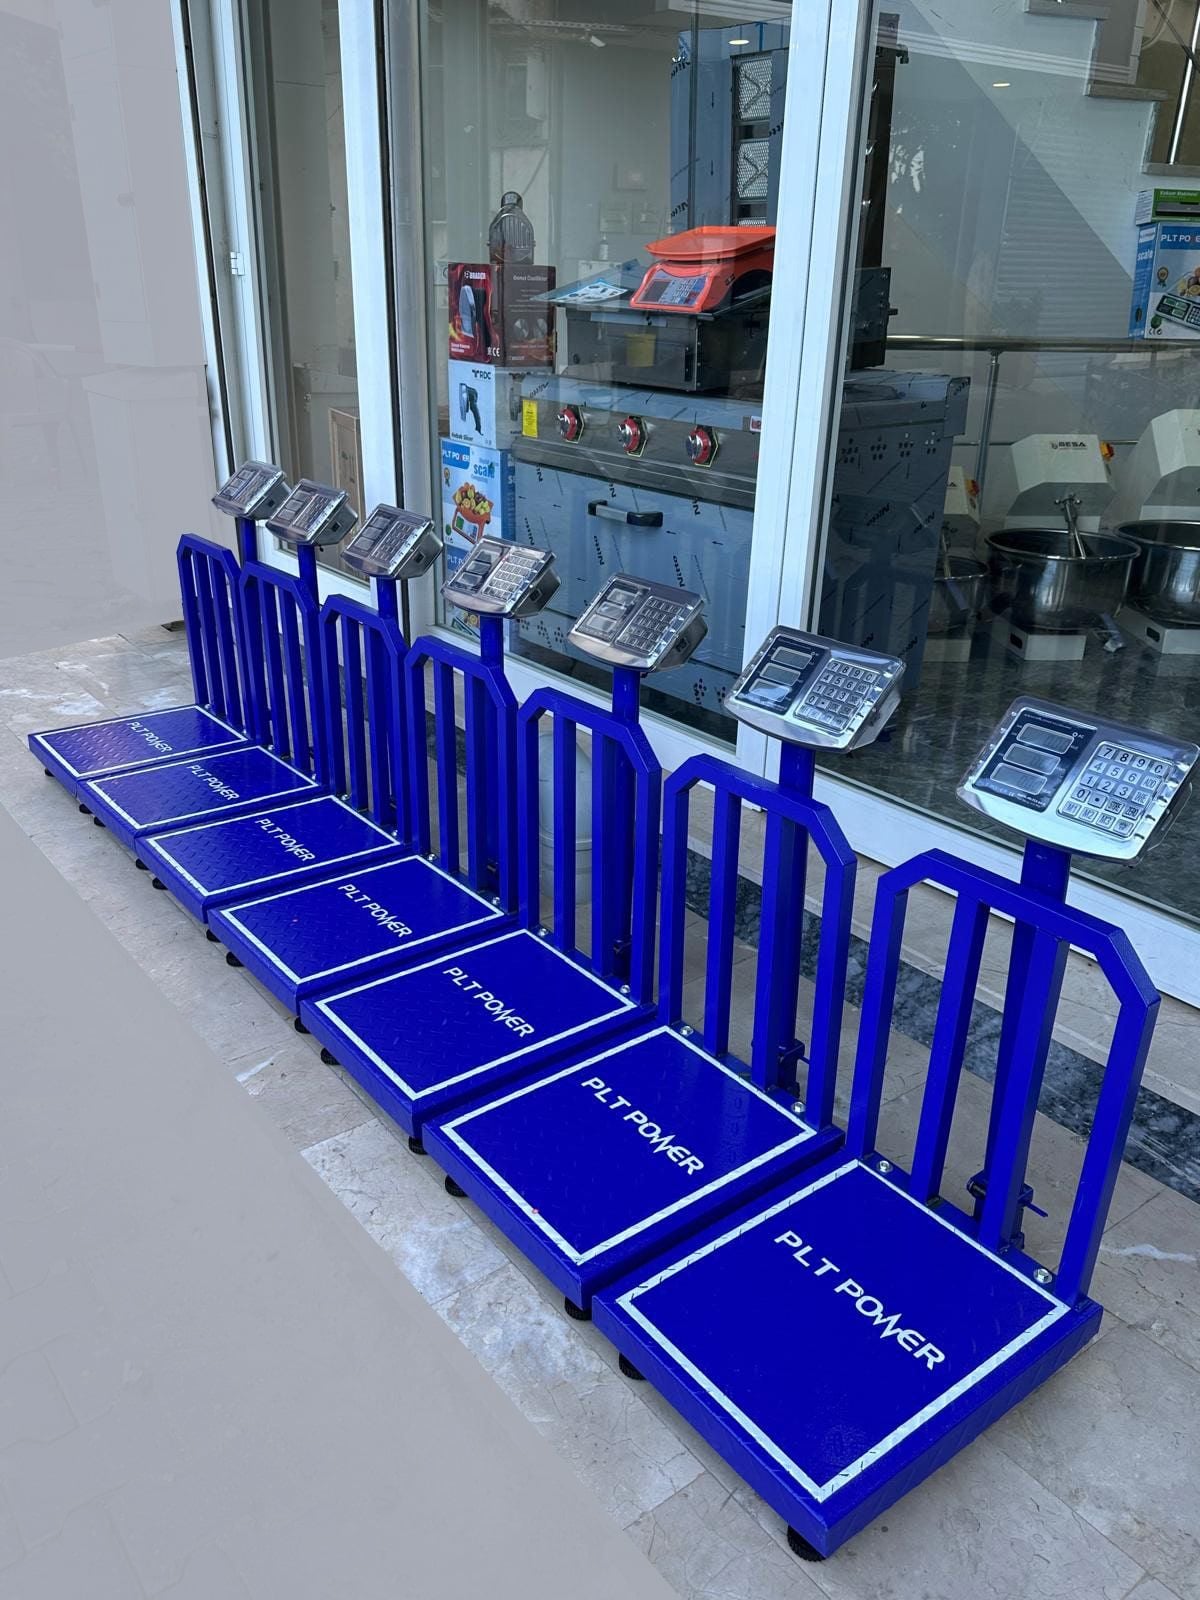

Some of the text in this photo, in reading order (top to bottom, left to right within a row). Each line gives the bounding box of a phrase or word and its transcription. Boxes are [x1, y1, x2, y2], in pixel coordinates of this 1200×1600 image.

[1160, 234, 1177, 242] PLT
[672, 555, 686, 588] Nitto
[126, 722, 172, 752] PLT POWER
[1093, 762, 1103, 771] 4
[1110, 767, 1120, 776] 5
[1128, 773, 1137, 782] 6
[1103, 747, 1113, 757] 7
[1120, 753, 1129, 762] 8
[1136, 758, 1146, 768] 9
[186, 764, 239, 800] PLT POWER
[1076, 789, 1086, 798] 0
[1087, 776, 1094, 784] 1
[1101, 781, 1111, 791] 2
[1119, 786, 1129, 796] 3
[1084, 809, 1095, 818] M2
[1101, 814, 1111, 823] M3
[255, 818, 315, 861] PLT POWER
[338, 883, 412, 938] PLT POWER
[443, 966, 534, 1038] PLT POWER
[580, 1077, 705, 1176] PLT POWER
[774, 1230, 946, 1371] PLT POWER
